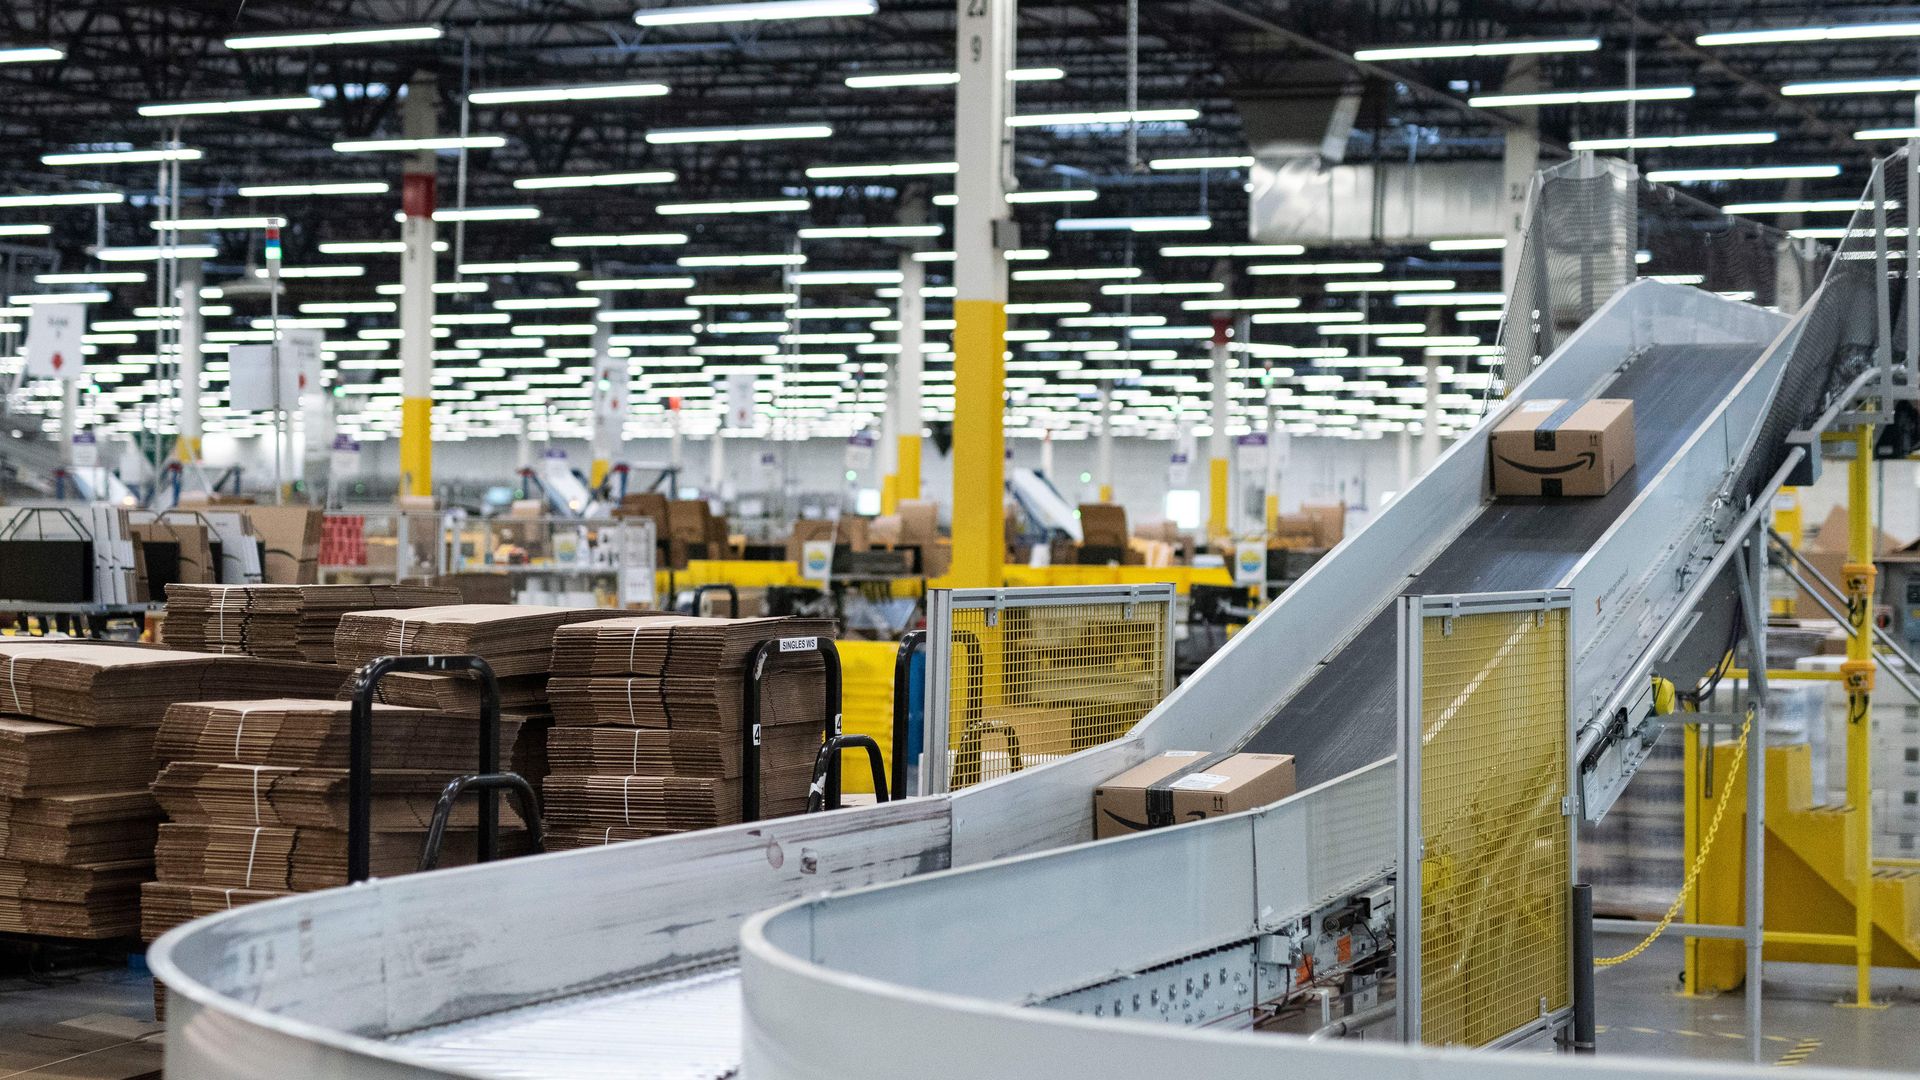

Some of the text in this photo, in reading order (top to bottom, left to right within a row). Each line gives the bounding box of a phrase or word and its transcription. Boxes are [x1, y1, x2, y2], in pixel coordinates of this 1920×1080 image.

[970, 34, 982, 62] 9
[782, 639, 816, 650] SINGLES WS
[755, 725, 760, 743] 4
